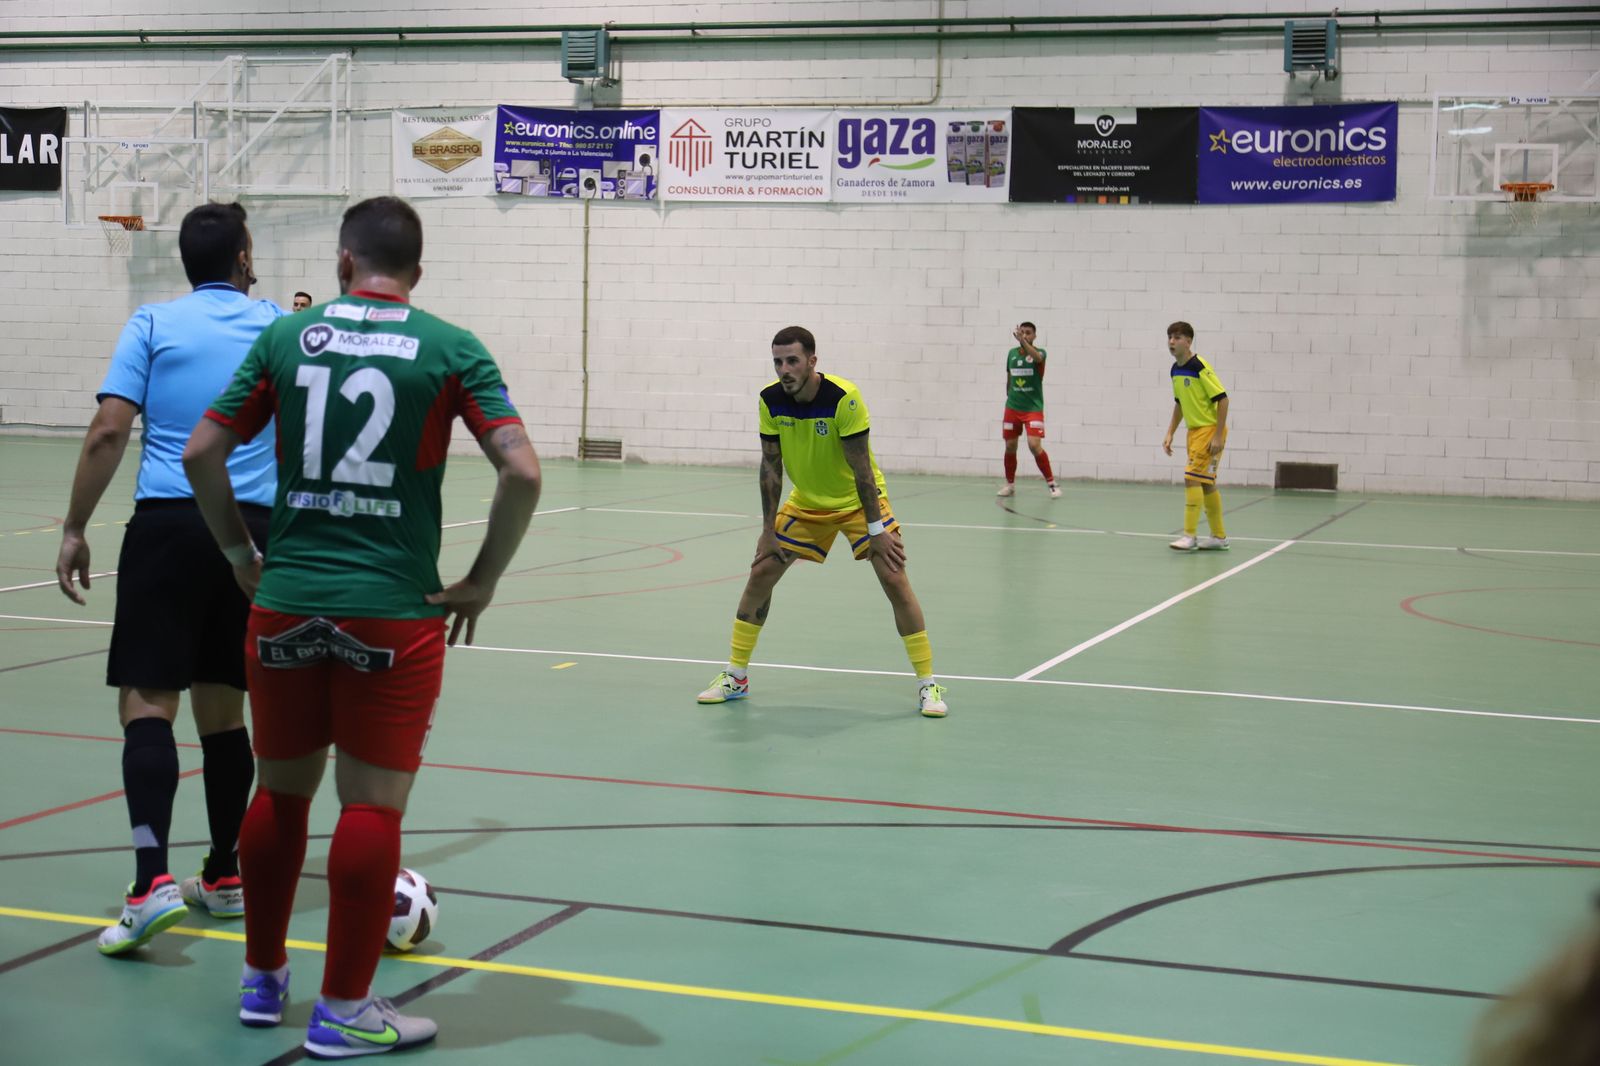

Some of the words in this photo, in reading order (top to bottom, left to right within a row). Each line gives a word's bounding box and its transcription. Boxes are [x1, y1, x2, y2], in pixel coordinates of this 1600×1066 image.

[459, 114, 490, 122] ASADOR
[724, 118, 772, 127] GRUPO
[515, 120, 656, 140] euronics.online
[1231, 120, 1387, 154] euronics
[725, 127, 825, 148] MARTÍN
[837, 117, 936, 170] gaza
[967, 135, 985, 145] gaza
[989, 135, 1008, 146] gaza
[1077, 140, 1132, 149] MORALEJO
[0, 133, 59, 164] LAR
[414, 145, 426, 155] EL
[429, 144, 480, 155] BRASERO
[724, 152, 819, 169] TURIEL
[1273, 153, 1386, 168] electrodomésticos
[725, 174, 824, 182] www.grupomartinturiel.es
[837, 178, 886, 187] Ganaderos
[887, 178, 898, 187] de
[901, 178, 935, 187] Zamora
[1231, 177, 1362, 191] www.euronics.es
[667, 185, 745, 195] CONSULTORÍA
[747, 186, 755, 195] &
[757, 185, 824, 196] FORMACIÓN
[338, 333, 416, 350] MORALEJO
[295, 364, 396, 487] 12
[288, 492, 330, 508] FISIO
[354, 498, 399, 515] LIFE
[271, 647, 293, 661] EL
